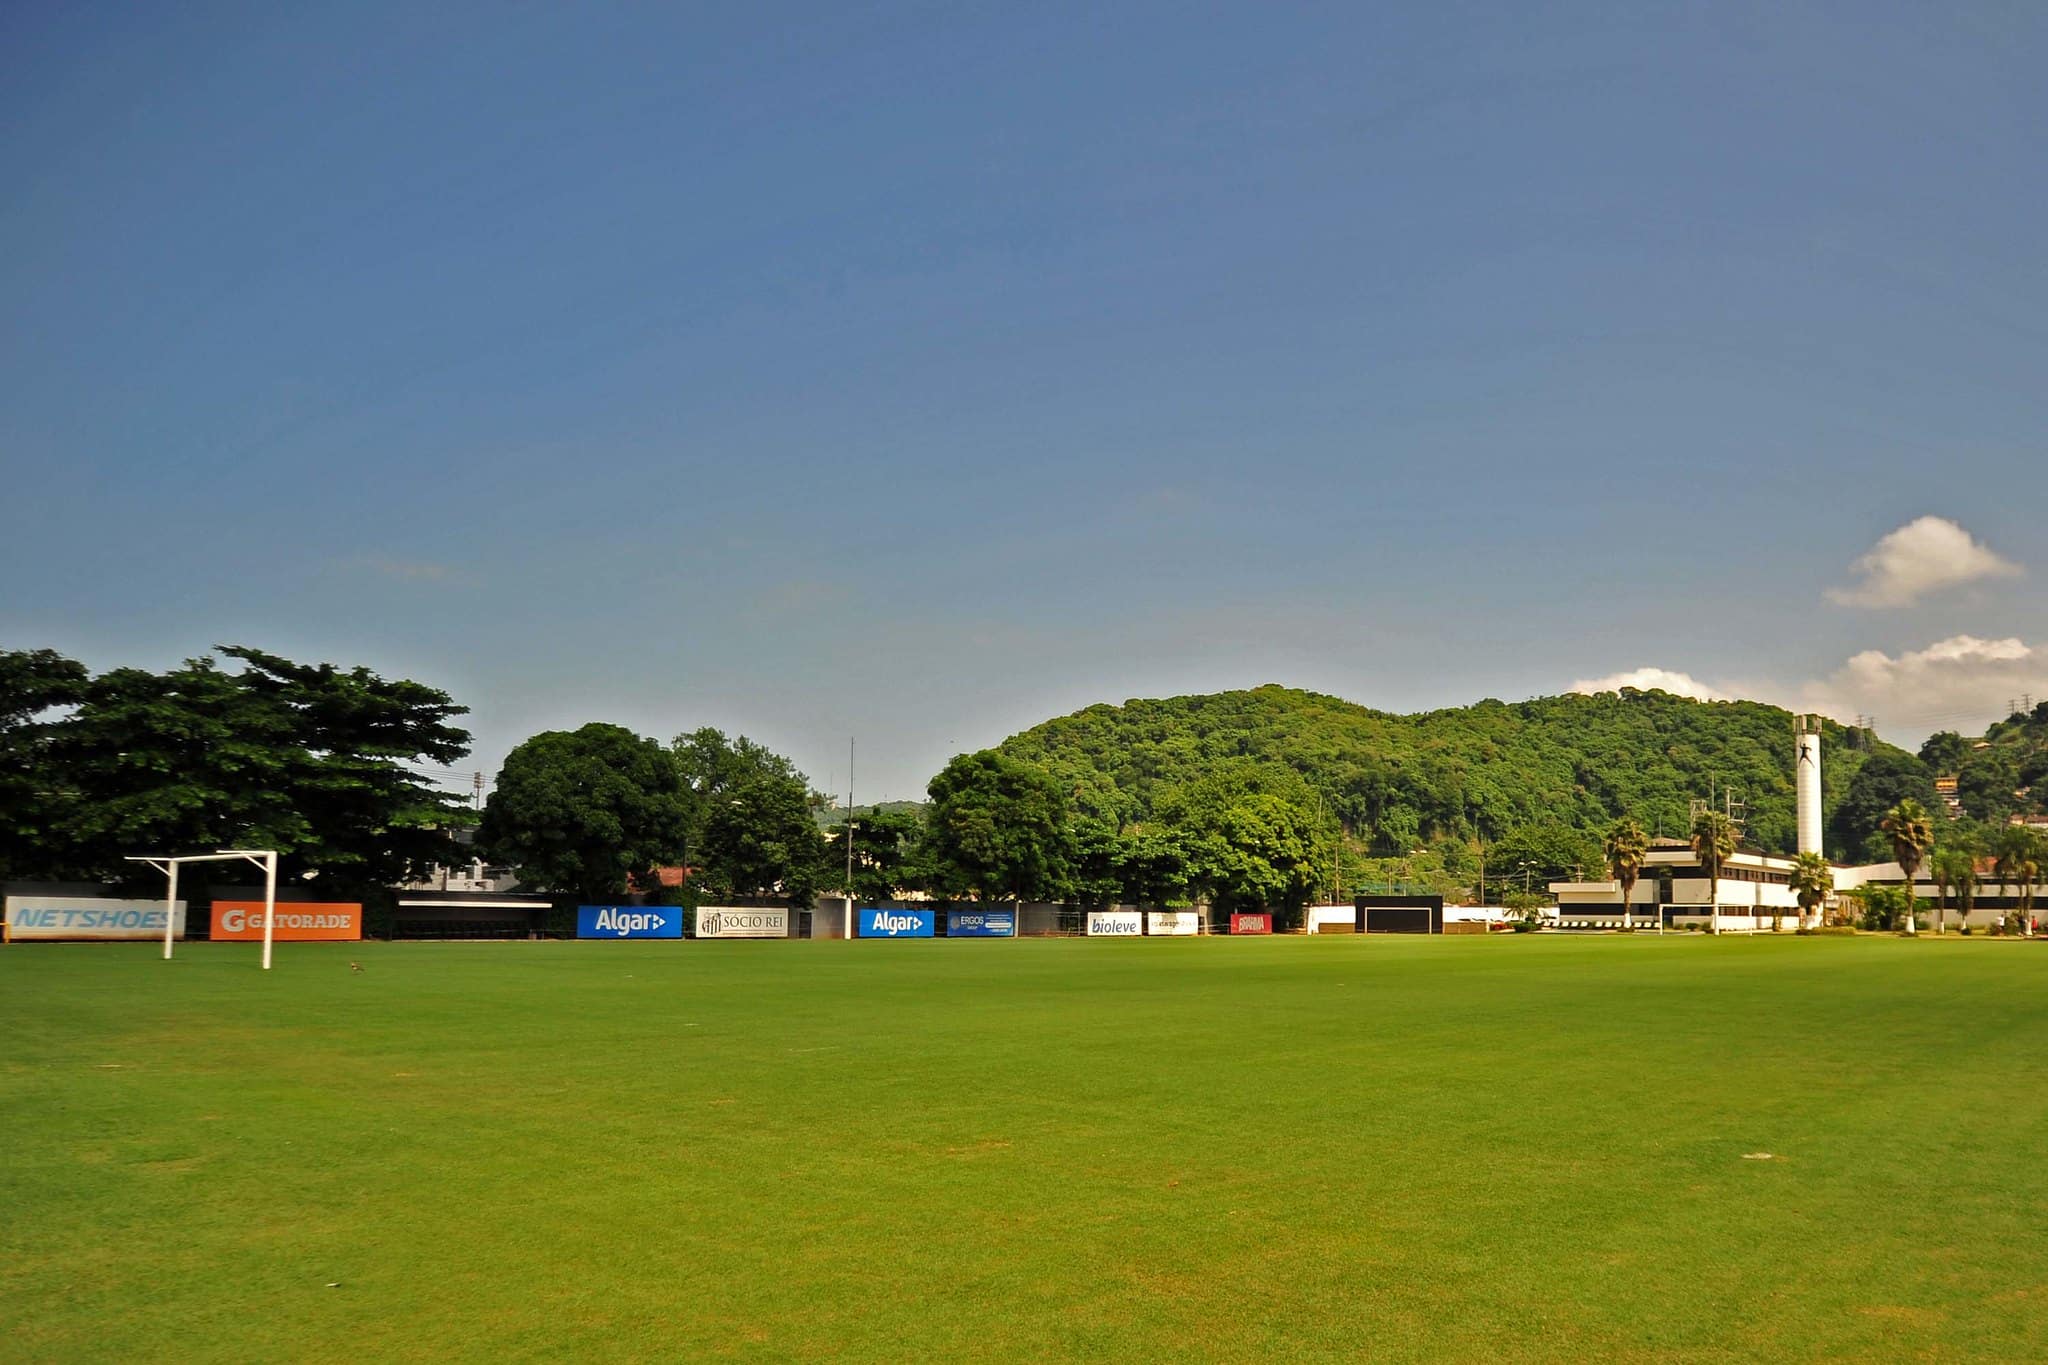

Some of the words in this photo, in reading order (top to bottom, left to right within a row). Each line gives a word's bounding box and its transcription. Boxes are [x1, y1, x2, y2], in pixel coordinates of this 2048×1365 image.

[14, 908, 178, 929] NETSHOES
[595, 907, 650, 936] Algar
[724, 914, 762, 928] SÓCIO
[766, 916, 783, 928] REI
[872, 911, 913, 935] Algar
[961, 916, 984, 925] ERGOS
[1092, 919, 1137, 933] bioleve
